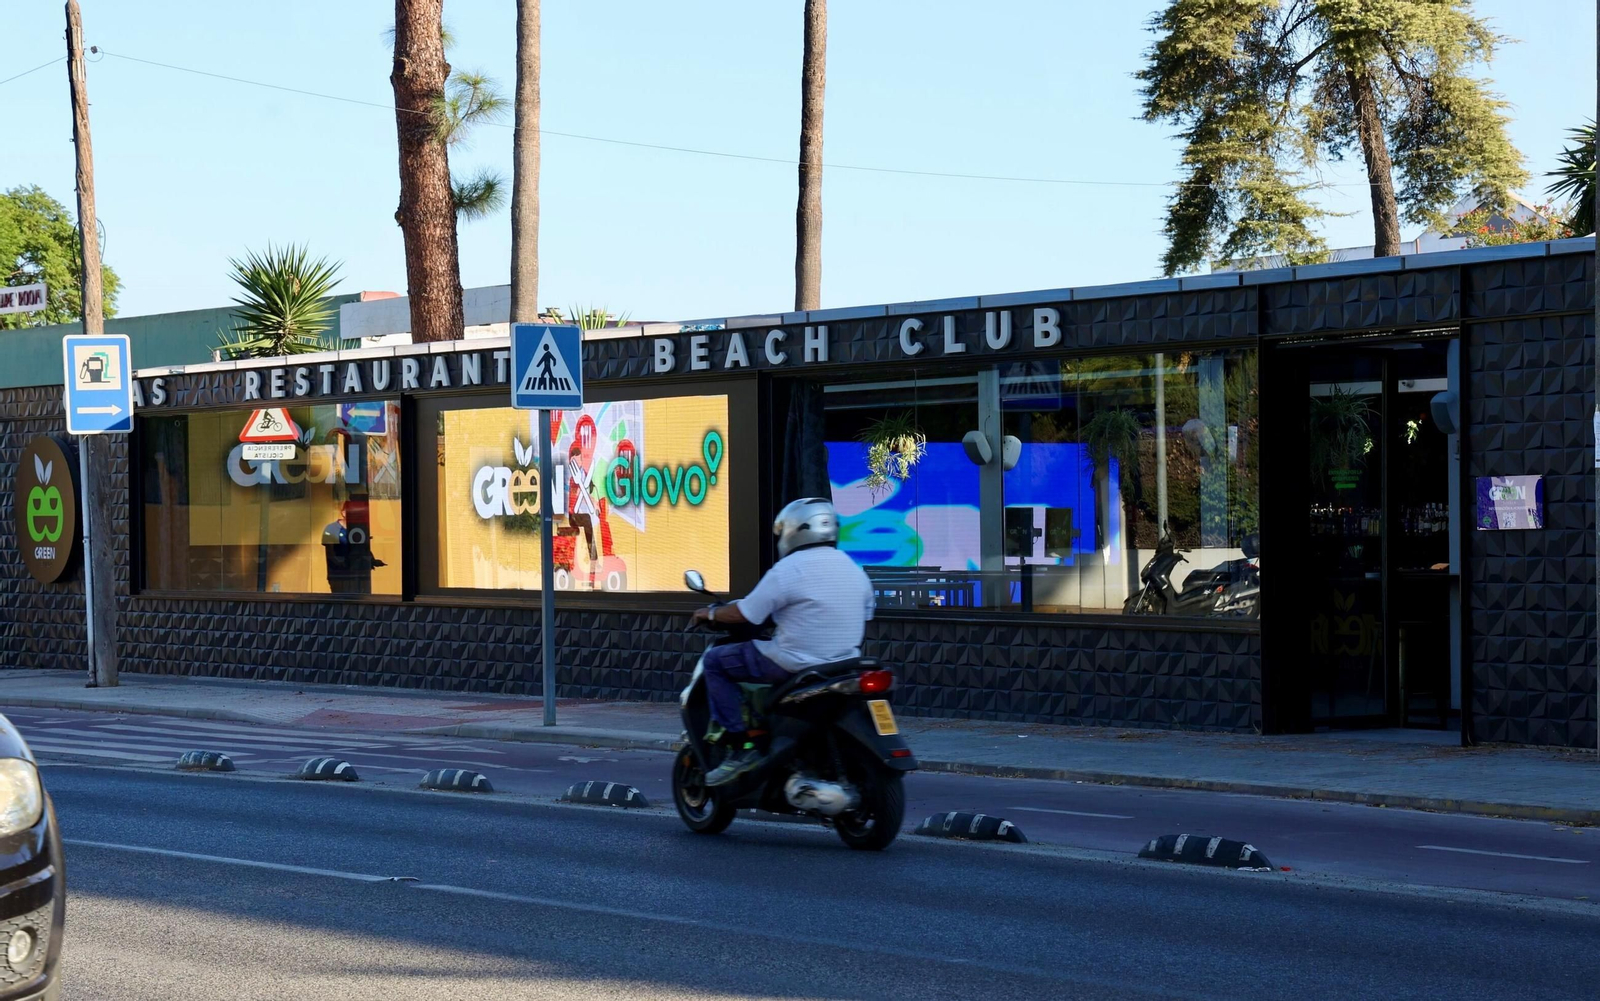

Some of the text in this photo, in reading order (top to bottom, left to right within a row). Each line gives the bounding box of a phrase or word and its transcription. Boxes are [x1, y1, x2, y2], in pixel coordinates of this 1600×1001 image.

[245, 350, 510, 400] RESTAURANT
[653, 325, 829, 373] BEACH
[900, 307, 1062, 356] CLUB
[34, 546, 56, 560] GREEN
